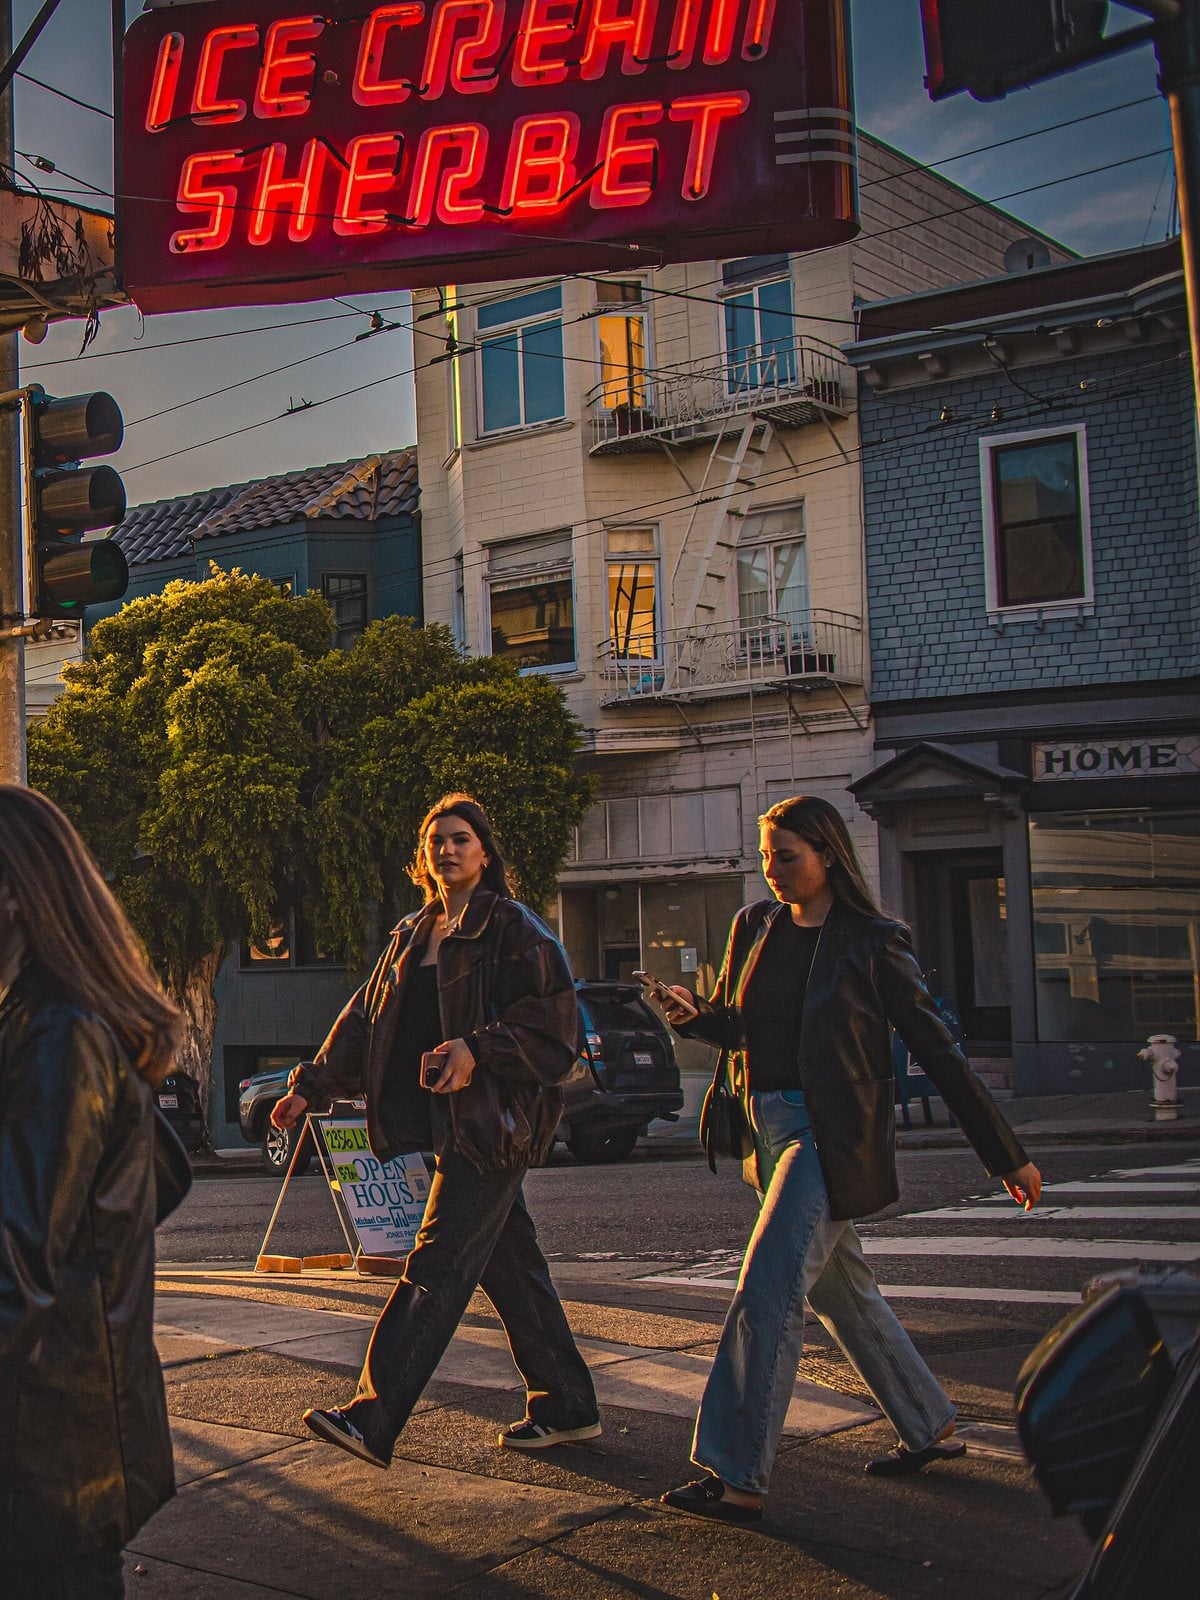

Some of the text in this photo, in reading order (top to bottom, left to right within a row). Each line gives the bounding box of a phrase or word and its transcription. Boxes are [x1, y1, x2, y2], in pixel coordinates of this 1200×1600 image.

[145, 0, 776, 133] ICE CREAM
[169, 90, 749, 254] SHERBET
[1044, 744, 1177, 773] HOME
[352, 1157, 407, 1182] OPEN
[351, 1181, 427, 1208] HOUS
[354, 1216, 375, 1225] Michael
[386, 1231, 404, 1239] JONES
